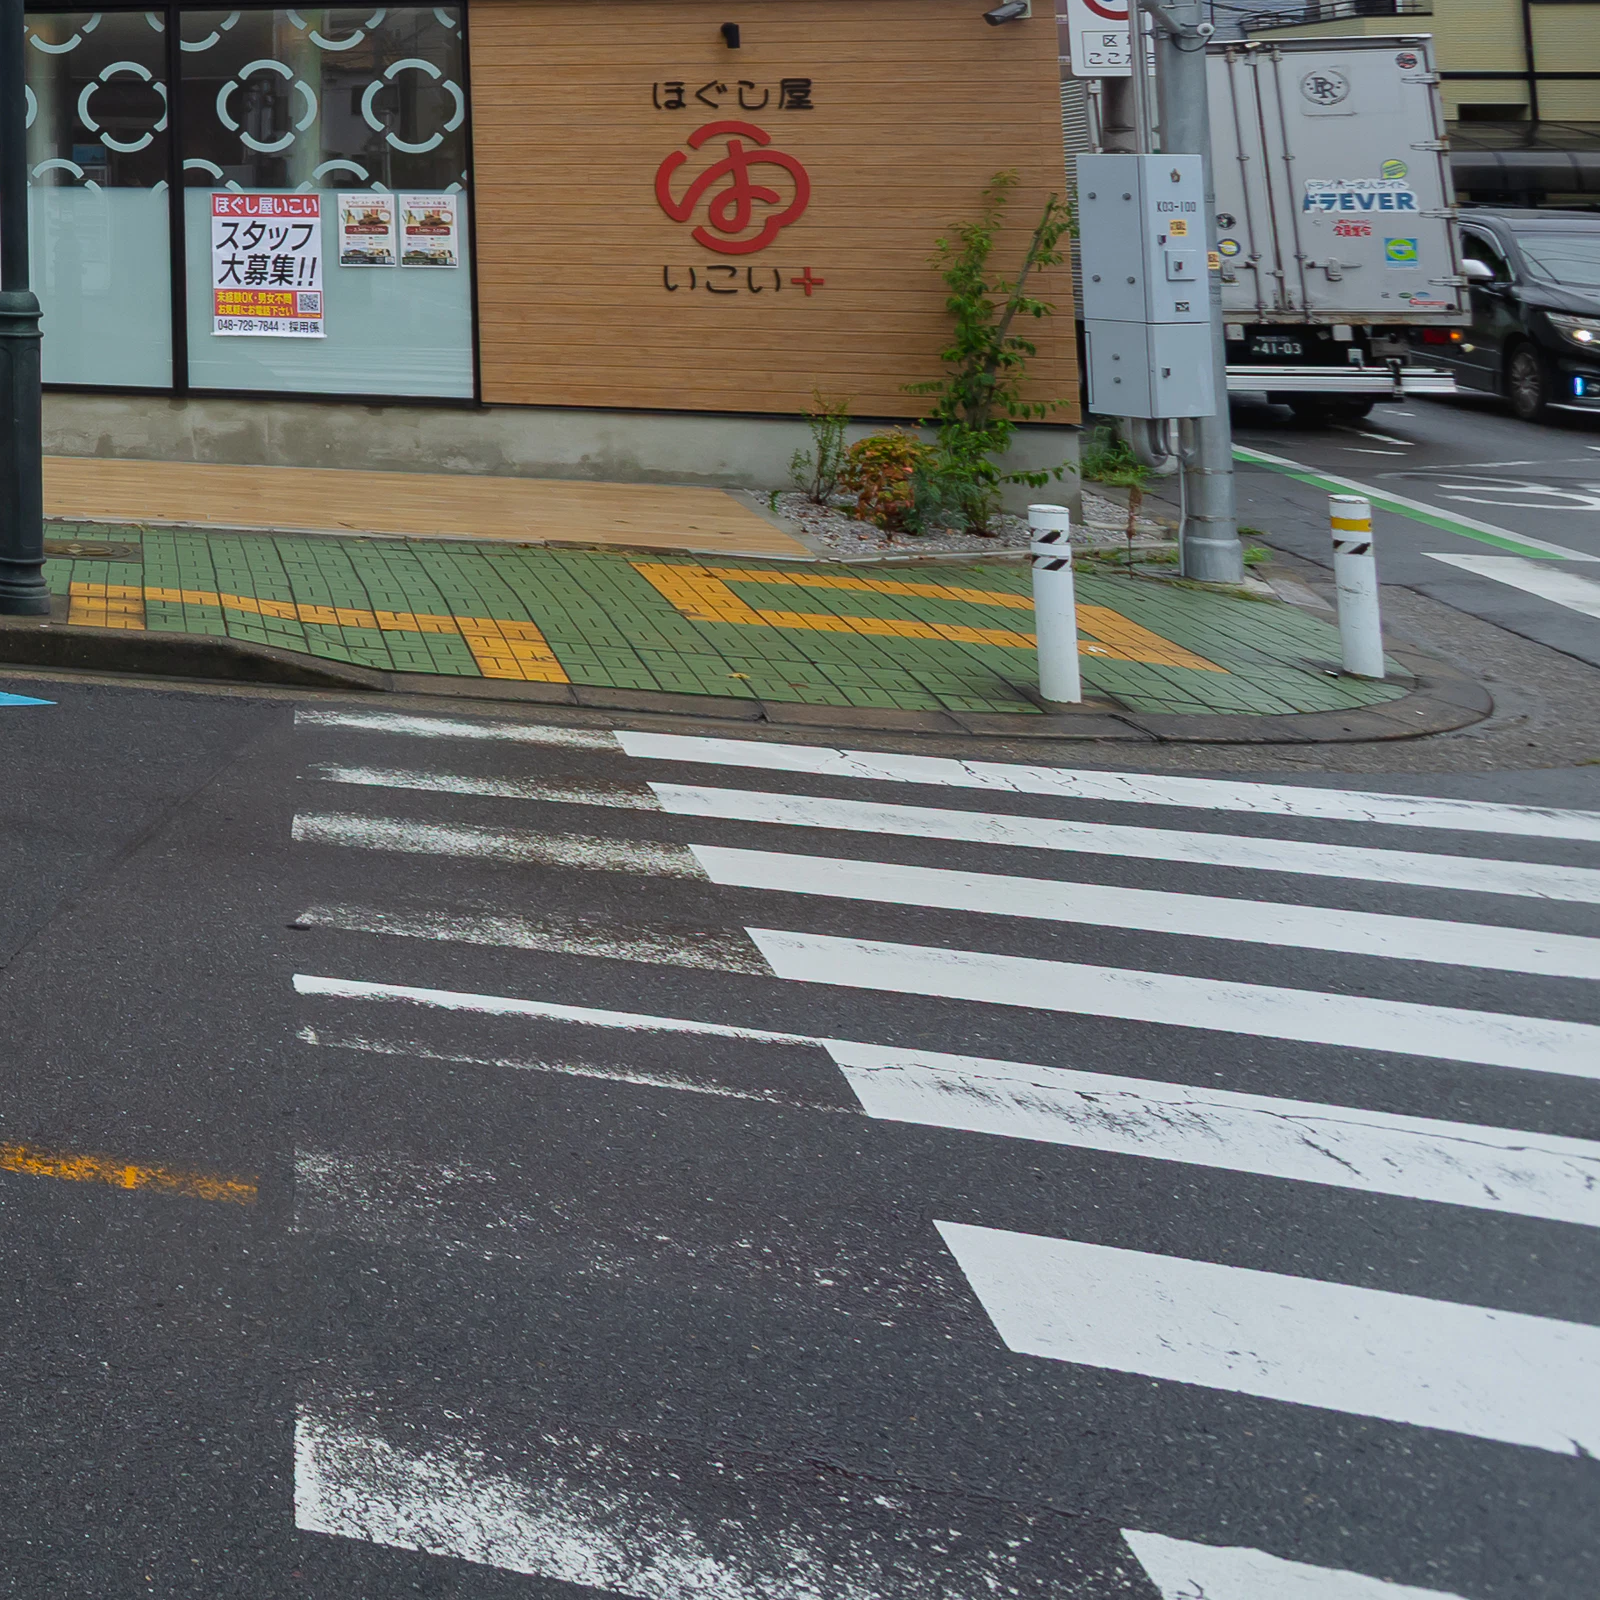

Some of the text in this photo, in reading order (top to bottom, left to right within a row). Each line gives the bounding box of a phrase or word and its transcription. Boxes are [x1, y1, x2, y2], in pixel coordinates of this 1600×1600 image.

[652, 78, 814, 110] ほぐし屋
[215, 196, 318, 215] ほぐし屋いこい
[215, 220, 314, 251] スタッフ
[217, 253, 317, 287] 大募集!!
[217, 304, 294, 316] お気軽にお電話下さい
